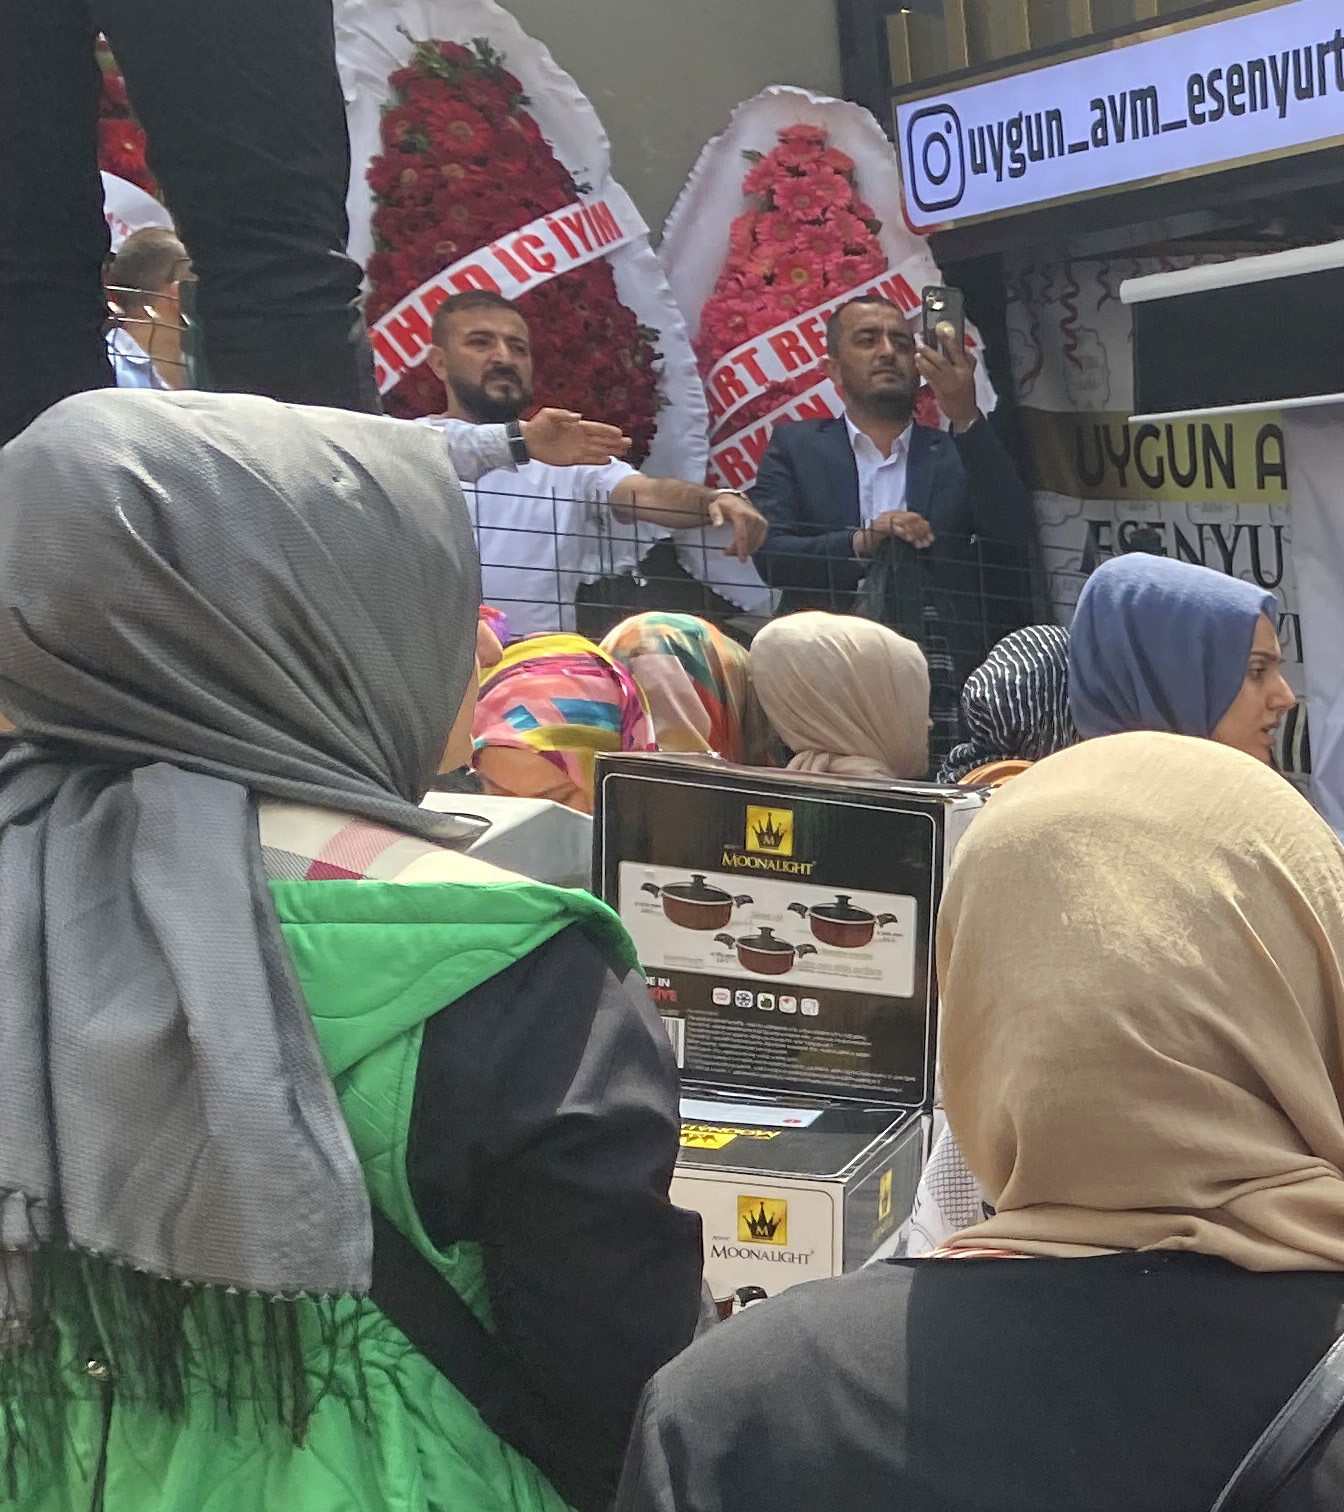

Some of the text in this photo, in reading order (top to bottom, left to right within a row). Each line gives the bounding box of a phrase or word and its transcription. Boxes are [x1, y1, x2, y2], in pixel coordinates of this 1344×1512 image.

[1075, 423, 1237, 490] UYGUN
[721, 850, 813, 876] MOONALIGHT
[710, 1243, 811, 1266] MOONALIGHT
